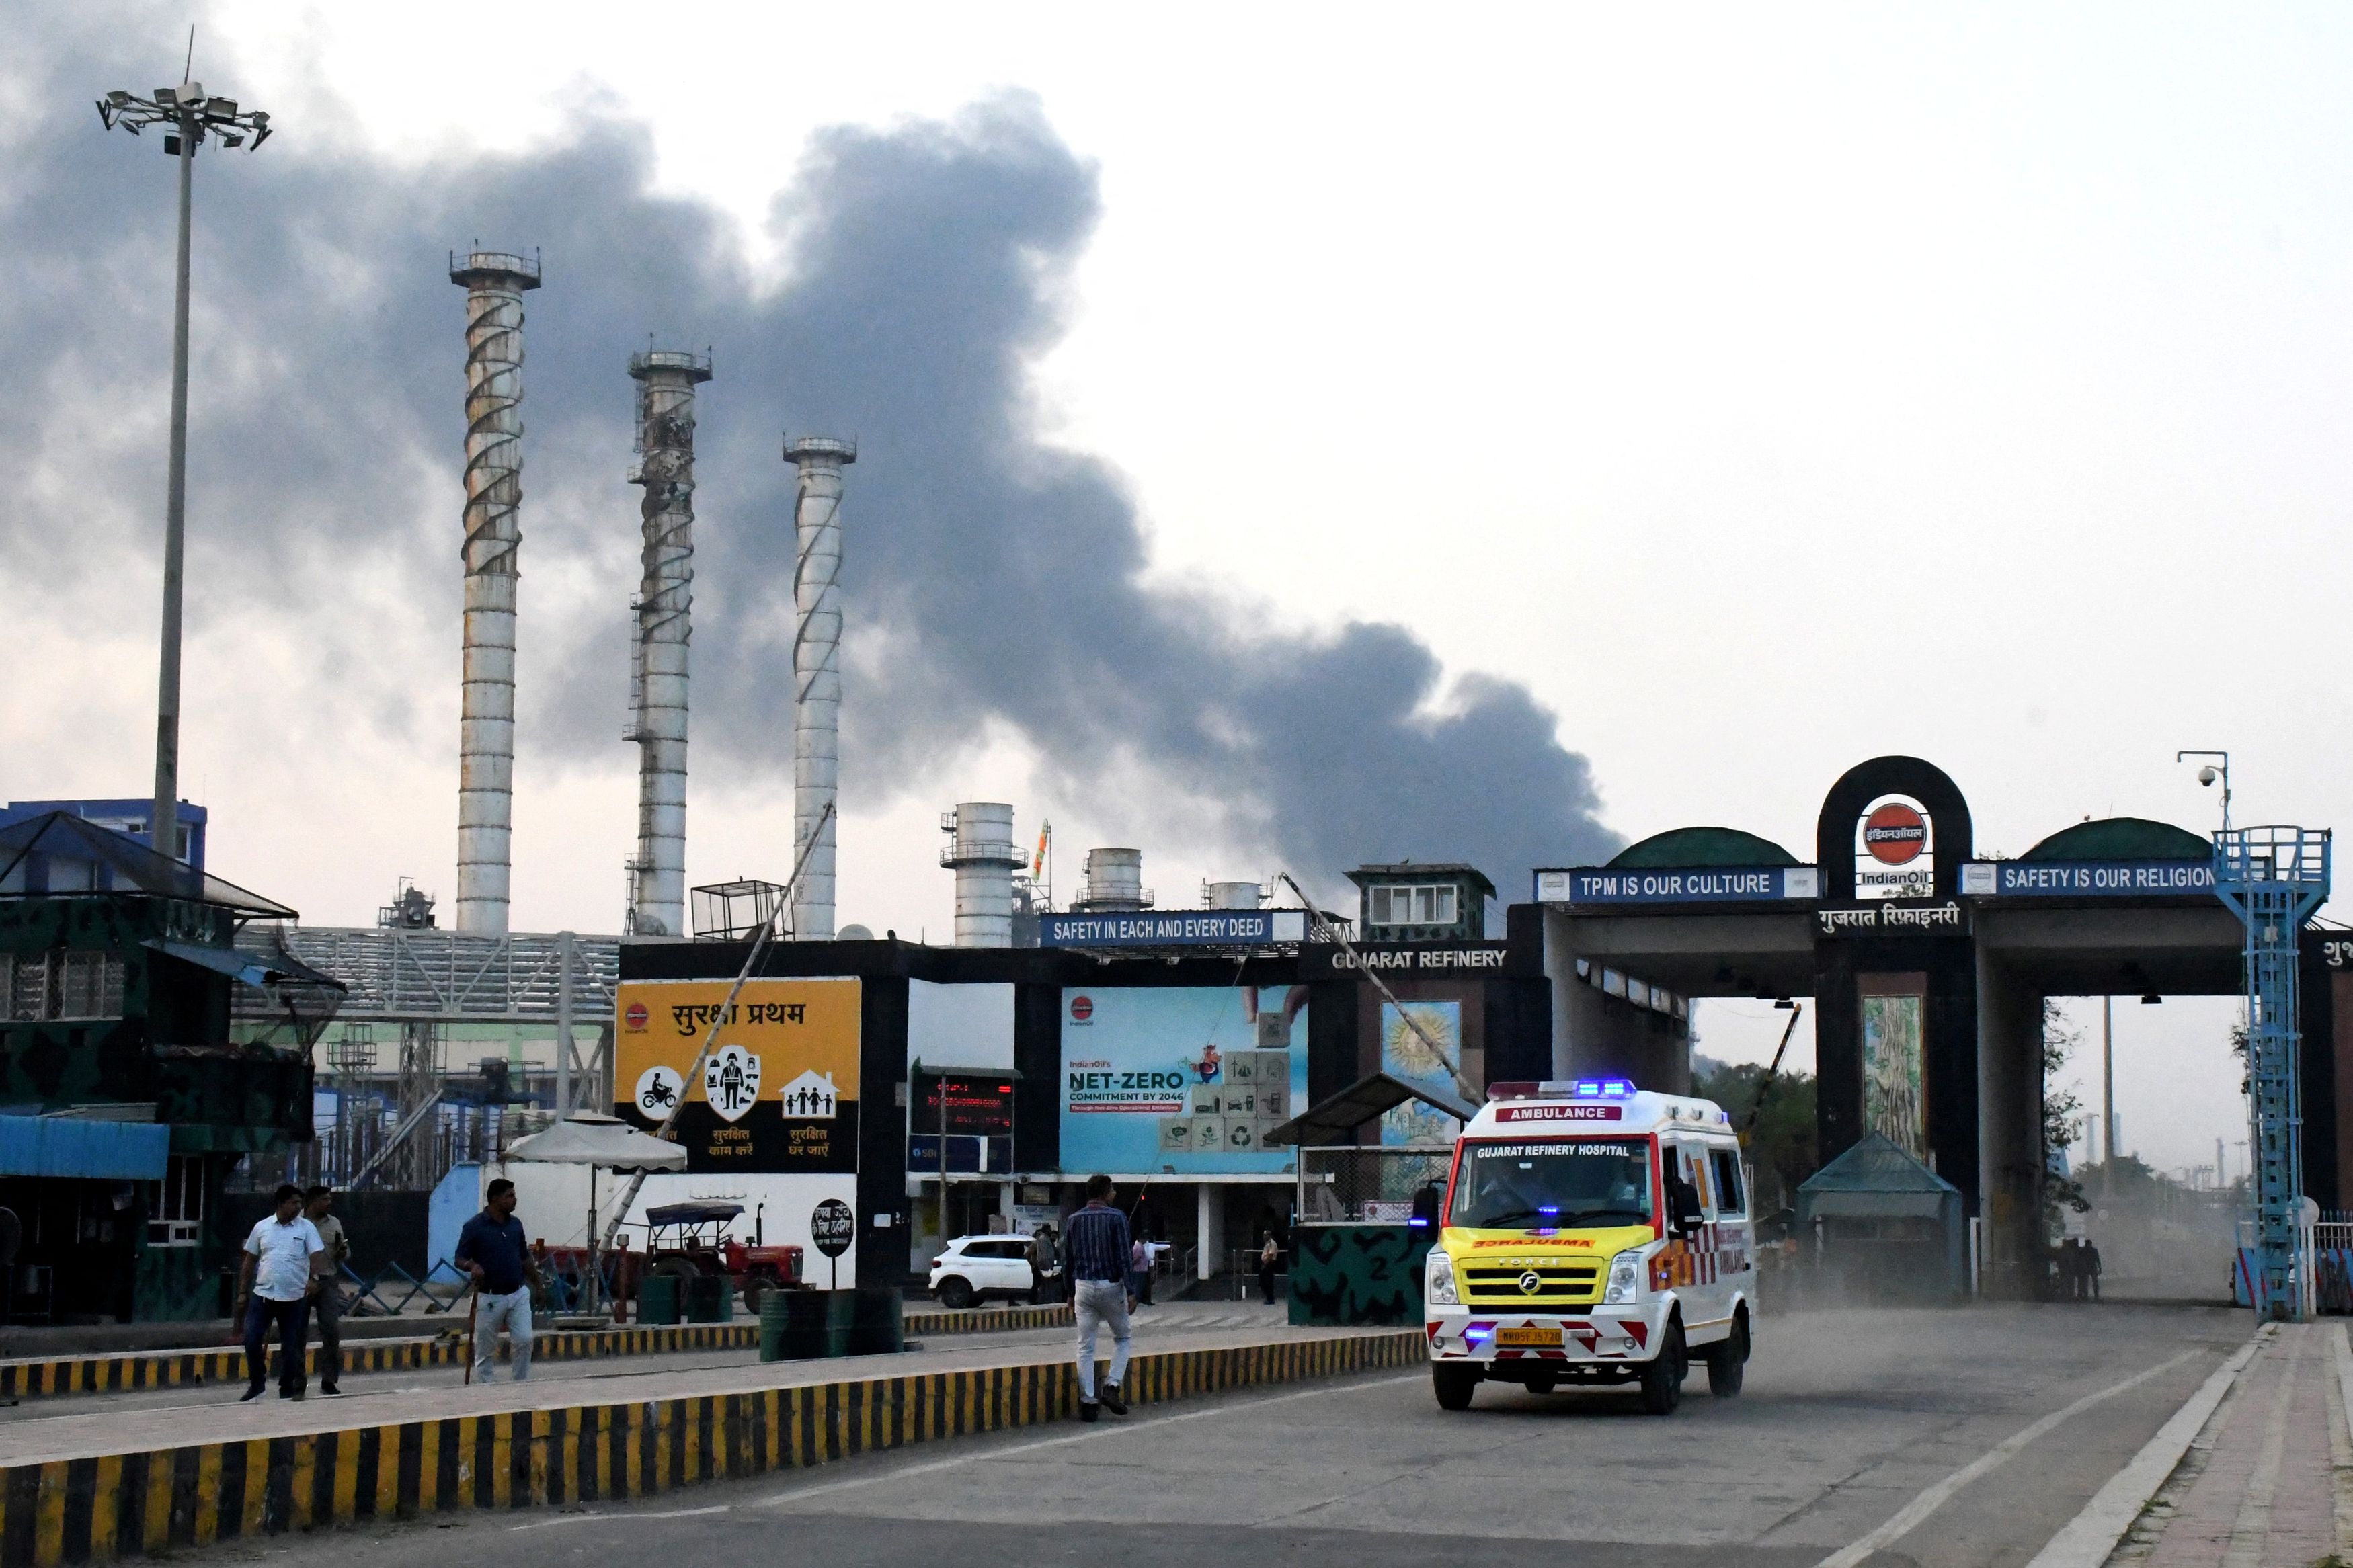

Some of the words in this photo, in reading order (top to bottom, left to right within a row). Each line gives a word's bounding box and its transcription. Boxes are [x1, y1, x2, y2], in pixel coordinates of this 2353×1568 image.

[1866, 827, 1923, 842] इंडियनऑयल
[1581, 878, 1616, 895] TPM
[1623, 877, 1638, 895] IS
[1644, 876, 1681, 895] OUR
[1687, 874, 1770, 894] CULTURE
[1862, 870, 1928, 884] IndianOil
[2005, 868, 2070, 888] SAFETY
[2075, 868, 2090, 888] IS
[2095, 868, 2131, 888] OUR
[1054, 921, 1101, 940] SAFETY
[1105, 920, 1117, 938] IN
[1120, 919, 1154, 938] EACH
[1156, 919, 1182, 938] AND
[1185, 919, 1226, 937] EVERY
[1230, 918, 1263, 936] DEED
[1818, 909, 1876, 934] गुजरात
[1419, 950, 1507, 968] REFINERY
[747, 1003, 807, 1025] प्रथम
[1070, 1060, 1111, 1068] IndianOil's
[1070, 1073, 1183, 1089] NET-ZERO
[1070, 1093, 1140, 1101] COMMITMENT
[1511, 1108, 1606, 1119] AMBULANCE
[713, 1126, 750, 1144] सुरक्षित
[789, 1126, 828, 1144] सुरक्षित
[709, 1145, 731, 1155] काम
[788, 1145, 804, 1155] घर
[1478, 1146, 1523, 1158] GUJARAT
[1525, 1145, 1577, 1156] REFINERY
[1578, 1145, 1630, 1157] HOSPITAL
[1499, 1257, 1560, 1266] FORCE
